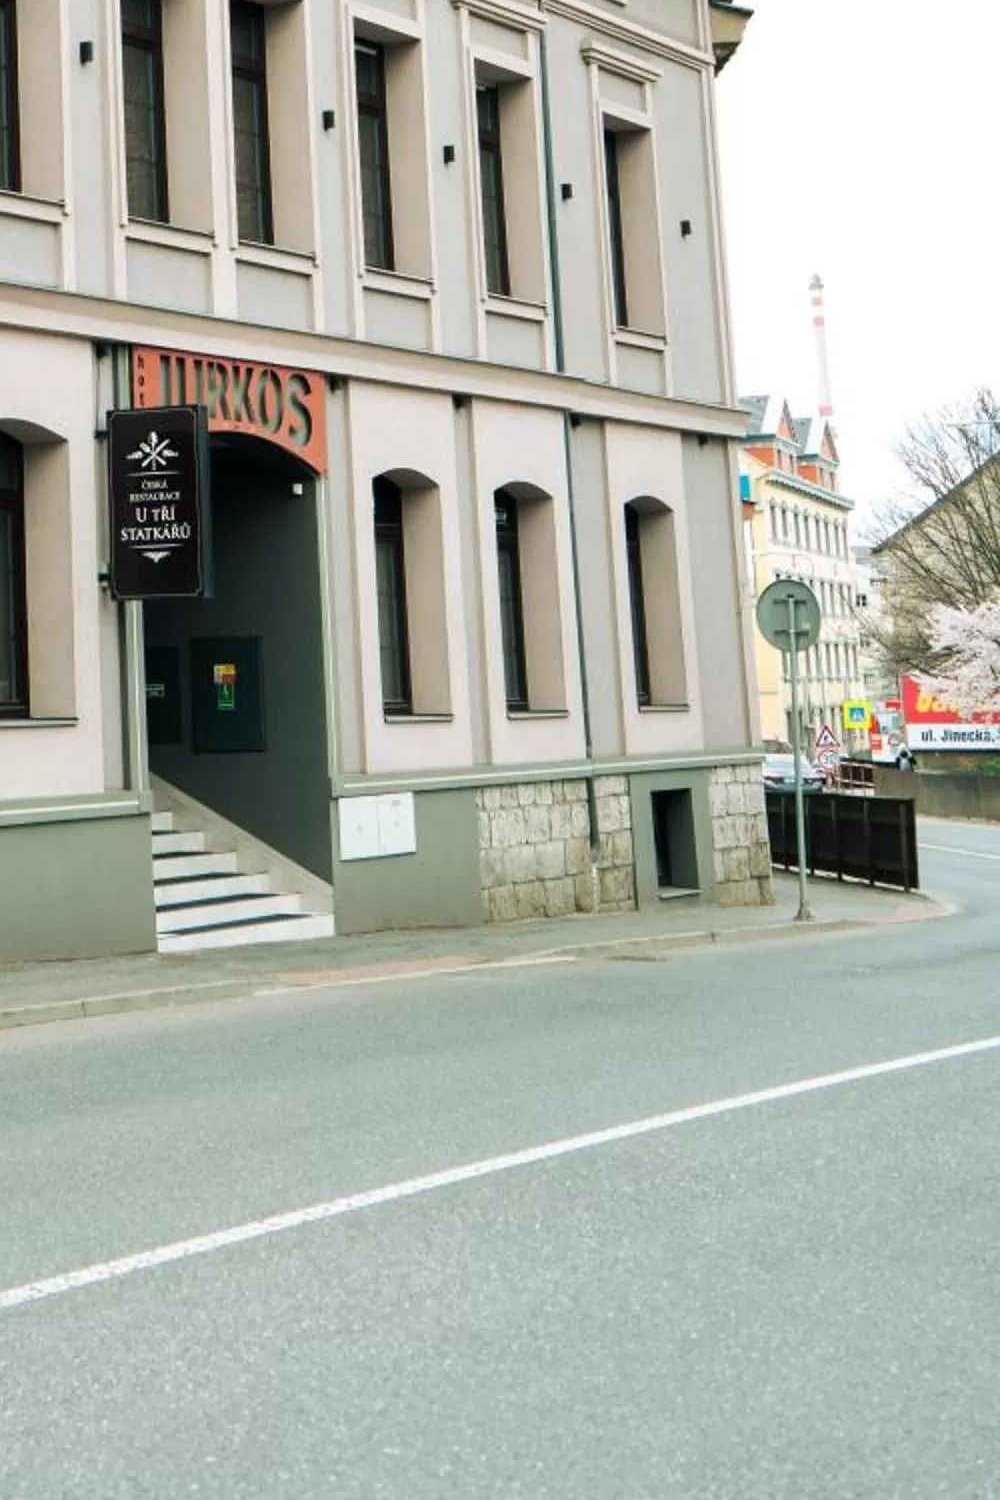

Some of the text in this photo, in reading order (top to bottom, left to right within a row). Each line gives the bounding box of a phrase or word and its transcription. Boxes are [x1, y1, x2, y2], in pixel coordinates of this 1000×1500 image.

[129, 492, 181, 503] RESTAURACE
[135, 504, 176, 523] U TŘÍ
[121, 521, 191, 541] STATKÁŘŮ
[921, 728, 937, 742] ul.
